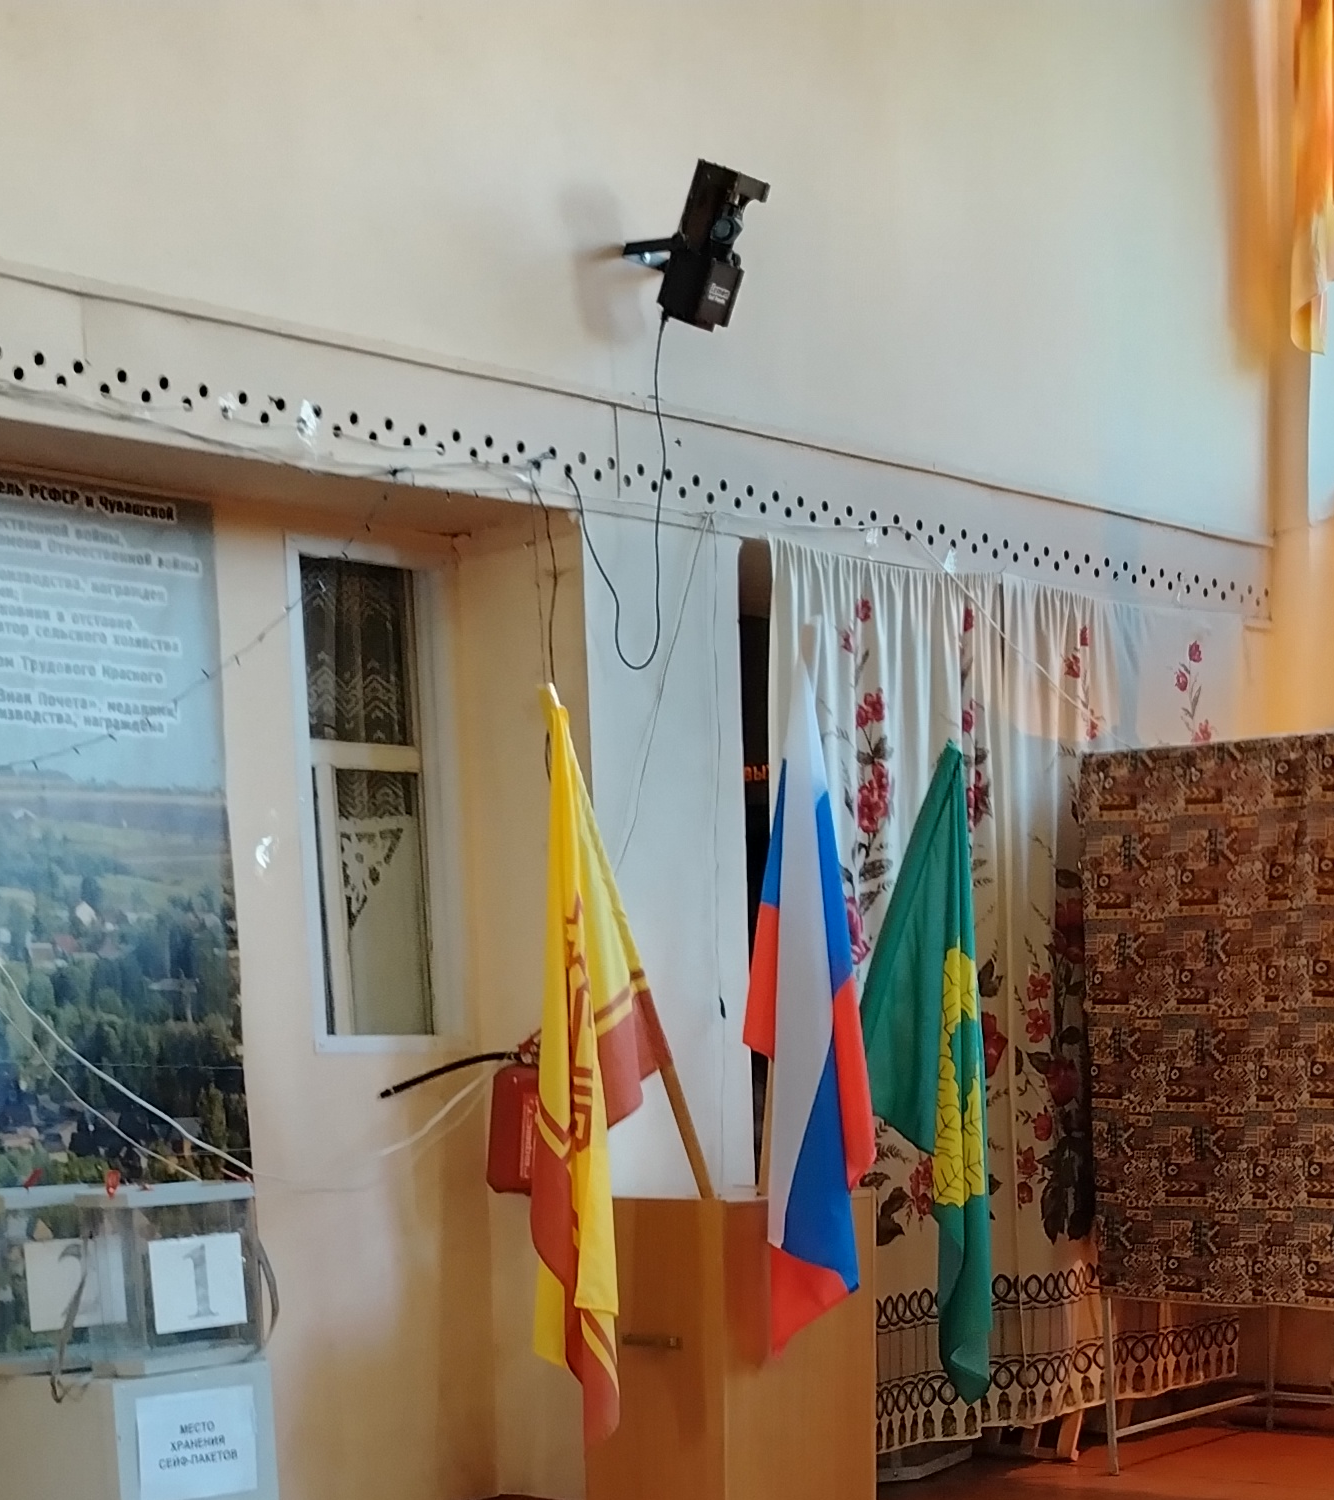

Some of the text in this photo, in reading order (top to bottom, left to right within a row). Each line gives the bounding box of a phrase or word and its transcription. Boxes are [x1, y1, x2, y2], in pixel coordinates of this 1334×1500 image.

[29, 482, 80, 505] РСФСР
[85, 495, 94, 508] и
[98, 495, 174, 521] Чувашской
[35, 624, 107, 645] сельского
[20, 655, 96, 677] Трудового
[102, 664, 163, 684] Красного
[83, 715, 164, 734] награждена
[183, 1244, 219, 1319] 1
[179, 1421, 215, 1435] МЕСТО
[170, 1434, 226, 1453] ХРАНЕНИЯ
[158, 1449, 238, 1470] СЕЙФ-ПАКЕТОВ
